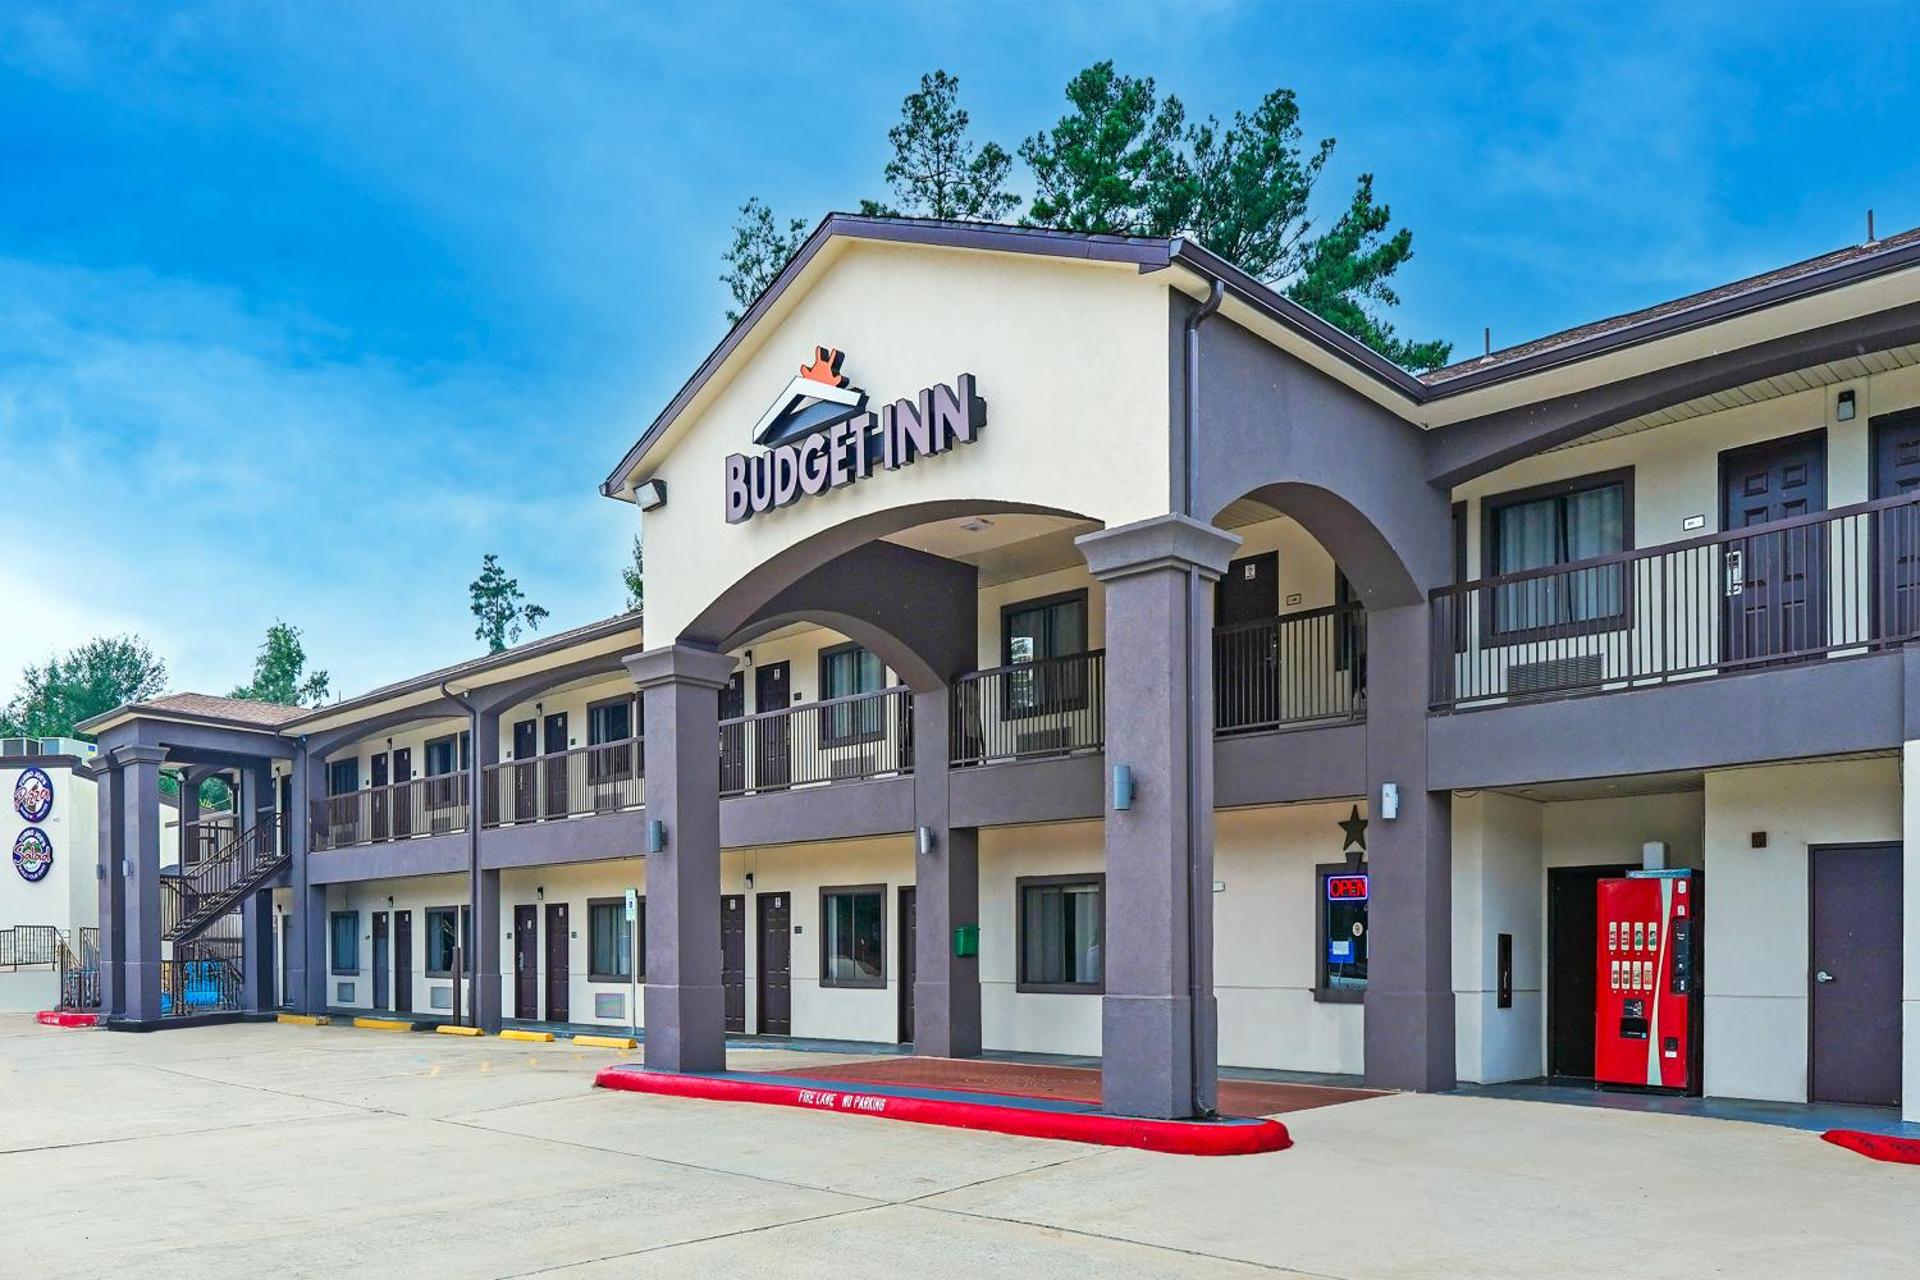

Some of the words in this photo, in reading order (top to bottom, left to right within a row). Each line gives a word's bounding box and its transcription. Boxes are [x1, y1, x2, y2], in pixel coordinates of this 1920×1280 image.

[726, 411, 876, 524] BUDGET
[883, 373, 977, 471] INN
[14, 786, 51, 812] Pizza
[13, 842, 52, 866] Salad
[1330, 879, 1367, 897] OPEN
[798, 1089, 816, 1104] FIRE
[816, 1092, 837, 1107] LANE
[842, 1095, 854, 1108] NO
[853, 1096, 886, 1112] PARKING
